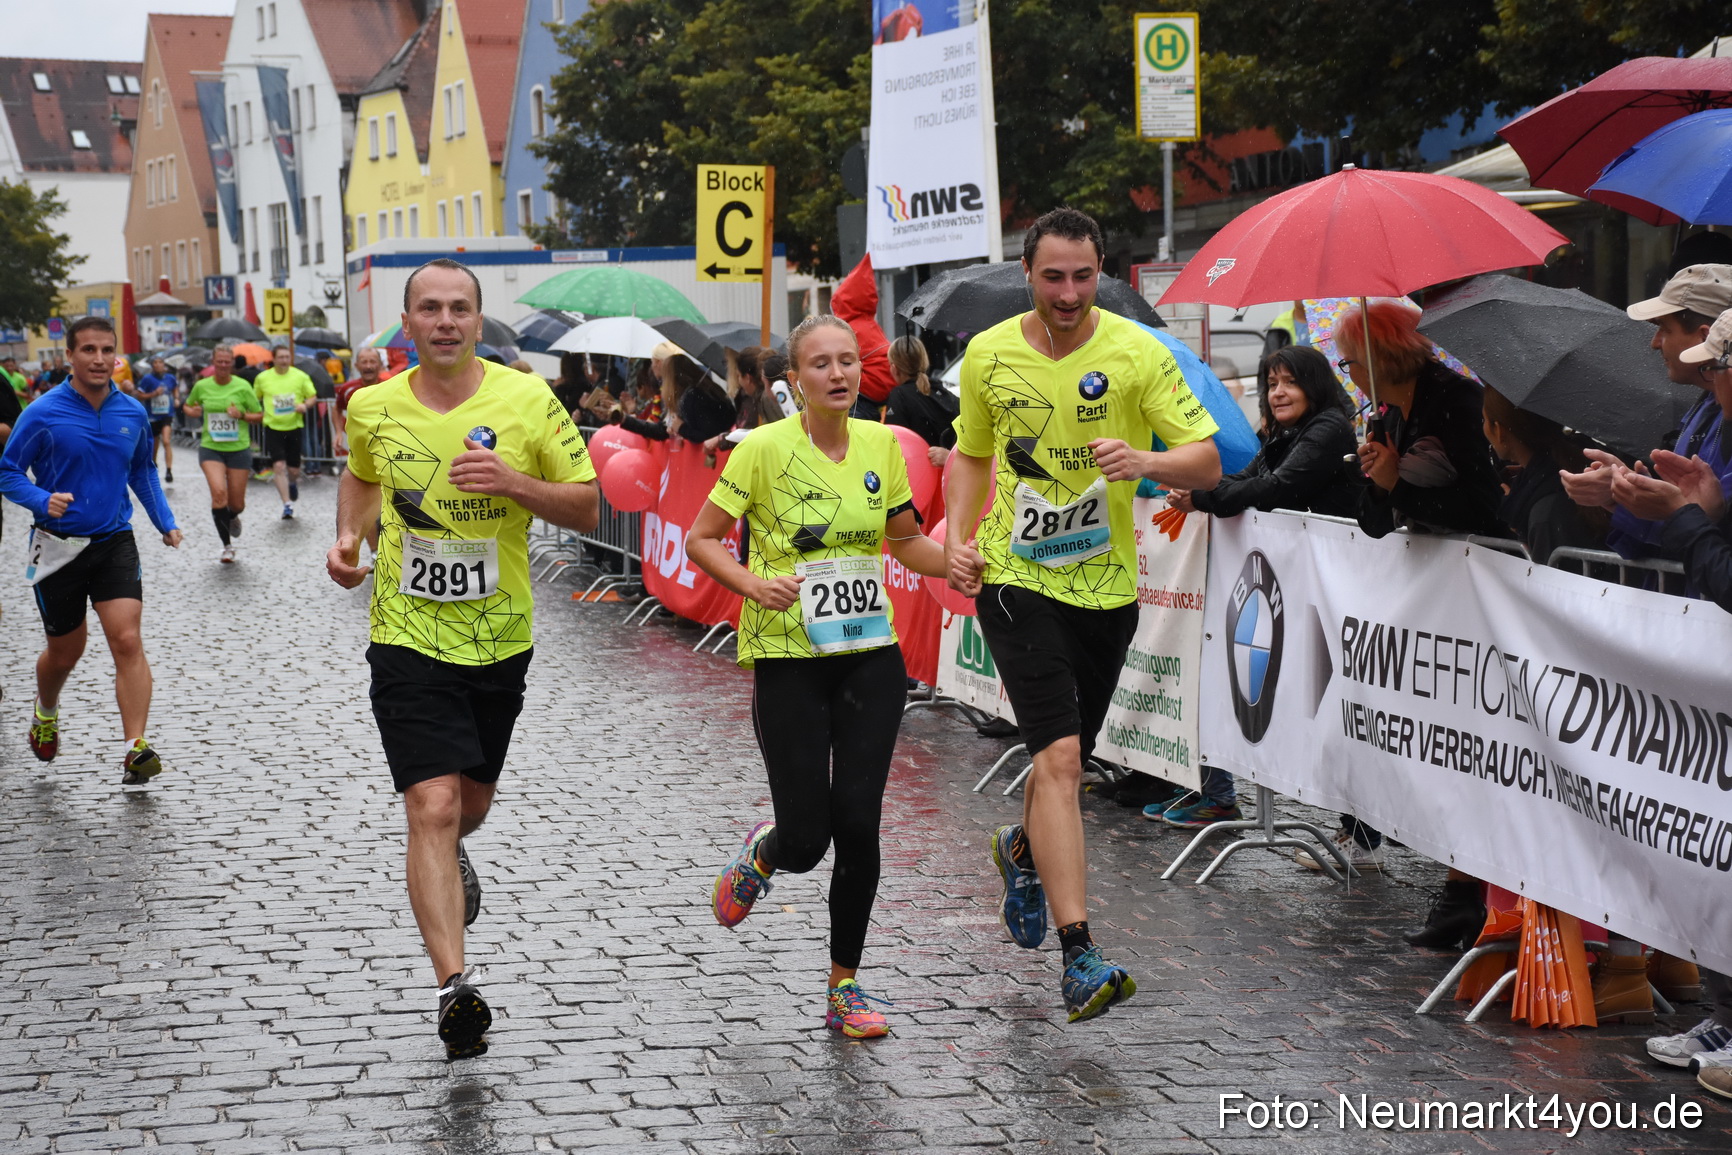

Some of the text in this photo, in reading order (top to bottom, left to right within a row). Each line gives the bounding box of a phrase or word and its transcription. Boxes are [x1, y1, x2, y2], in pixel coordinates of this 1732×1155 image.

[1148, 76, 1186, 84] Marktplatz
[707, 170, 764, 191] Block
[715, 201, 753, 257] C
[271, 302, 285, 324] D
[1077, 402, 1107, 417] Partl
[211, 420, 237, 431] 2351
[1078, 415, 1107, 423] Neumarkt
[1047, 446, 1094, 459] THE NEX
[1060, 460, 1080, 471] 100
[729, 482, 750, 500] Partl
[436, 498, 492, 510] THE NEXT
[450, 507, 507, 522] 100 YEARS
[1021, 498, 1100, 541] 2872
[836, 530, 877, 541] THE NEXT
[1030, 538, 1092, 560] Johannes
[841, 560, 876, 571] BOCK
[1138, 554, 1149, 576] 52
[410, 557, 487, 597] 2891
[811, 578, 882, 618] 2892
[842, 623, 863, 637] Nina
[1341, 615, 1409, 692] BMW
[1341, 698, 1732, 872] WENIGER VERBRAUCH. MEHR FAHRFREUD
